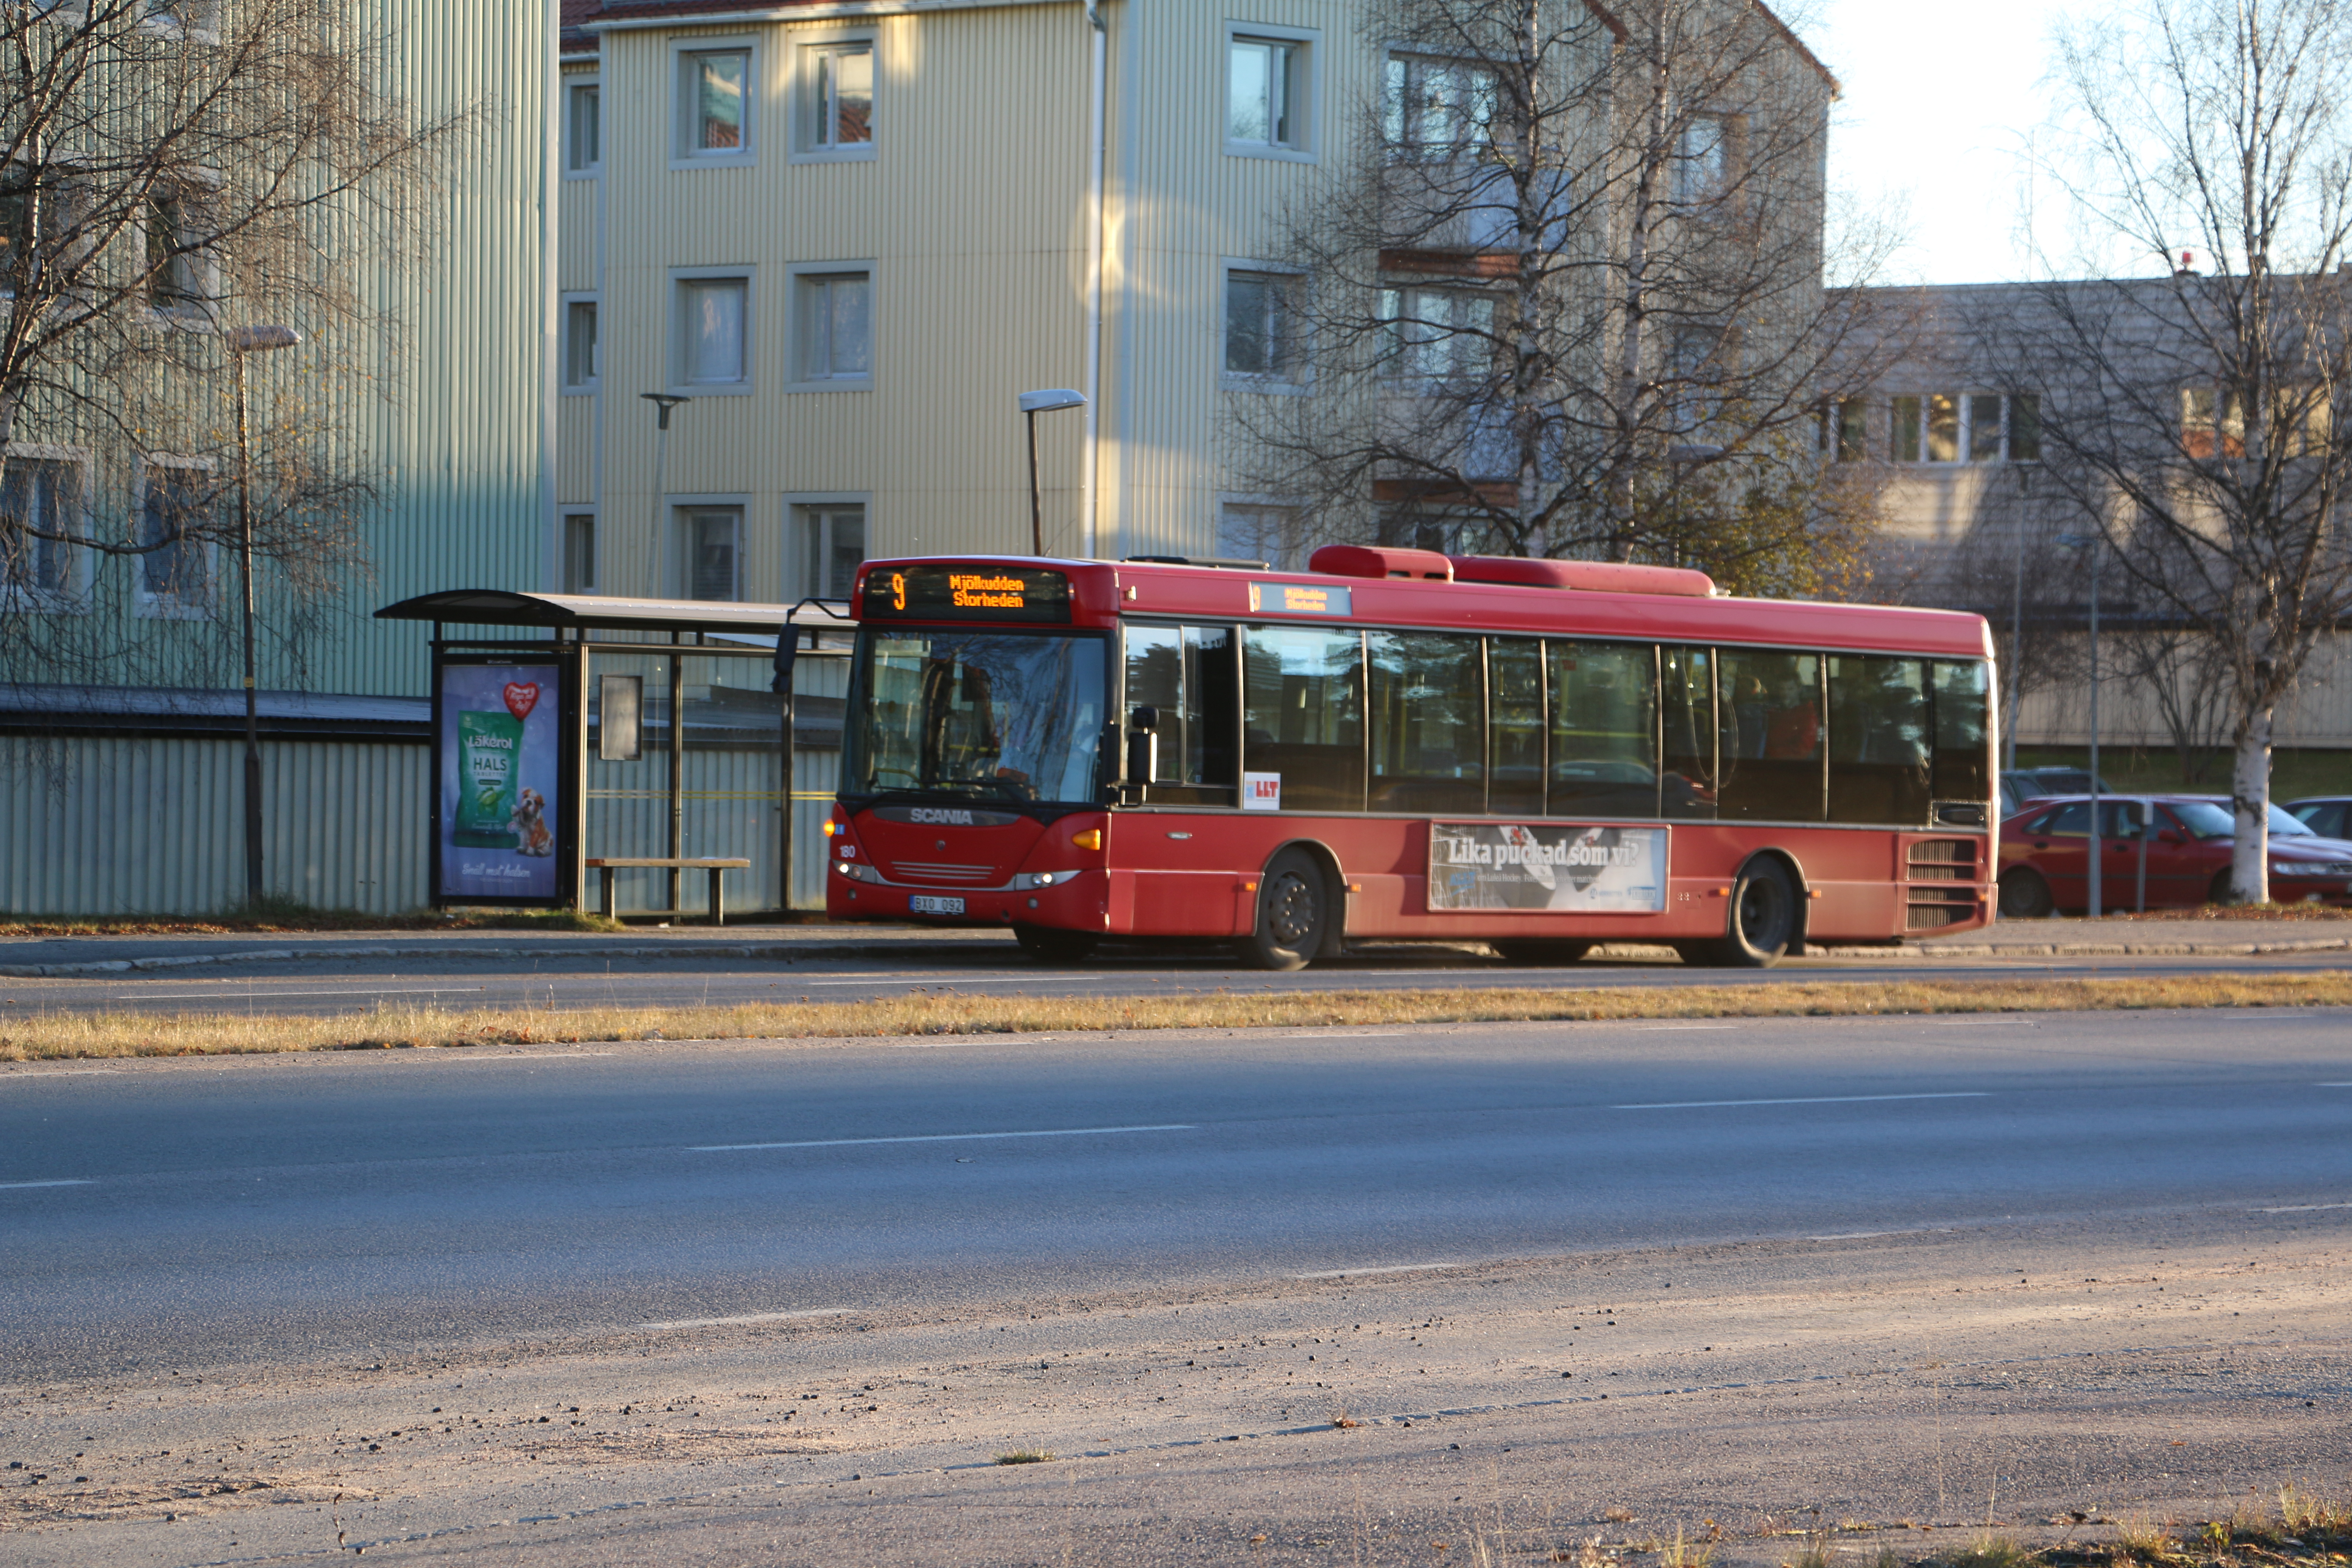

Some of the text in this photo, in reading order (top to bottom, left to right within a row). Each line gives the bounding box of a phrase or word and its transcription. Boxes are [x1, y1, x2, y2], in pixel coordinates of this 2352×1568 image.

[949, 575, 1025, 591] Mjölkudden
[892, 573, 905, 610] 9
[953, 591, 1024, 607] Storheden
[1253, 585, 1261, 611] 9
[1284, 588, 1328, 600] Mjölkudden
[1285, 598, 1326, 611] Storheden
[468, 735, 513, 749] Läkerol
[474, 758, 506, 771] HALS
[1256, 781, 1279, 798] LLT
[910, 808, 974, 825] SCANIA
[839, 845, 856, 858] 180
[1448, 838, 1641, 871] Lika puckad som vi?
[916, 897, 962, 911] BXO 092
